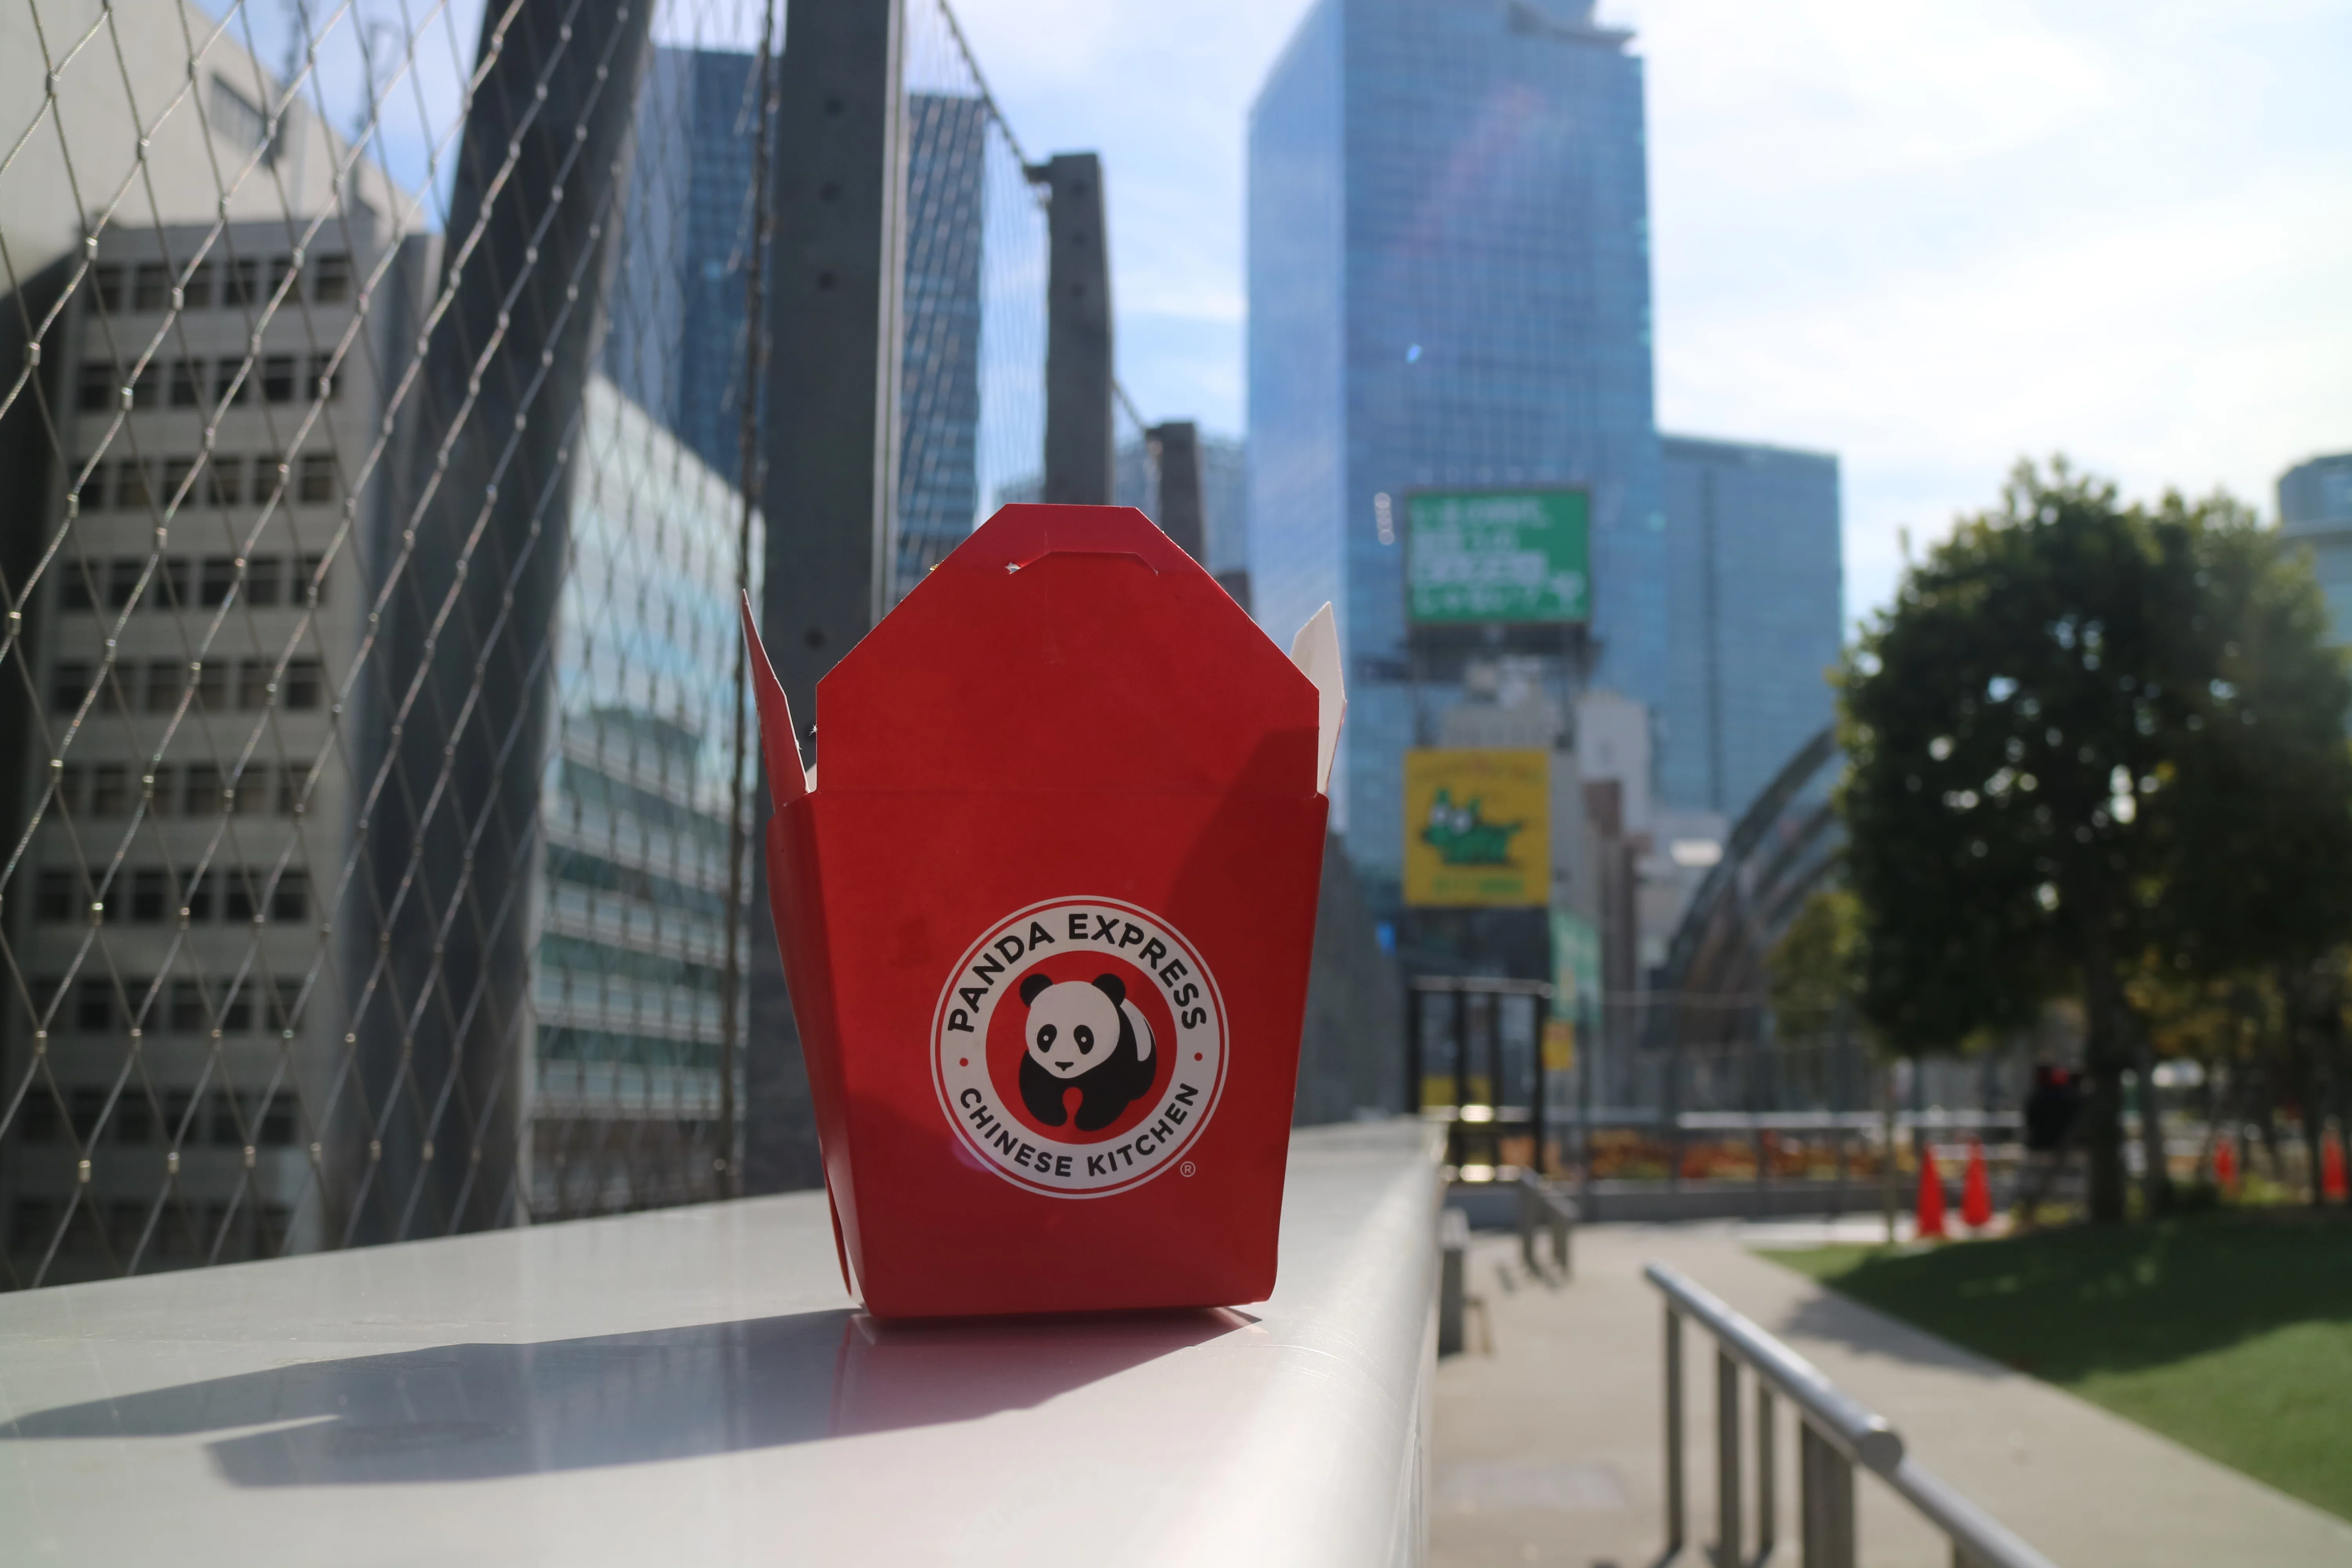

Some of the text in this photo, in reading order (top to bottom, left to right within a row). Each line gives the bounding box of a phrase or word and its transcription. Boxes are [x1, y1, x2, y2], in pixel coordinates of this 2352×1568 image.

[947, 913, 1207, 1033] PANDA EXPRESS
[960, 1083, 1199, 1177] CHINESE KITCHEN
